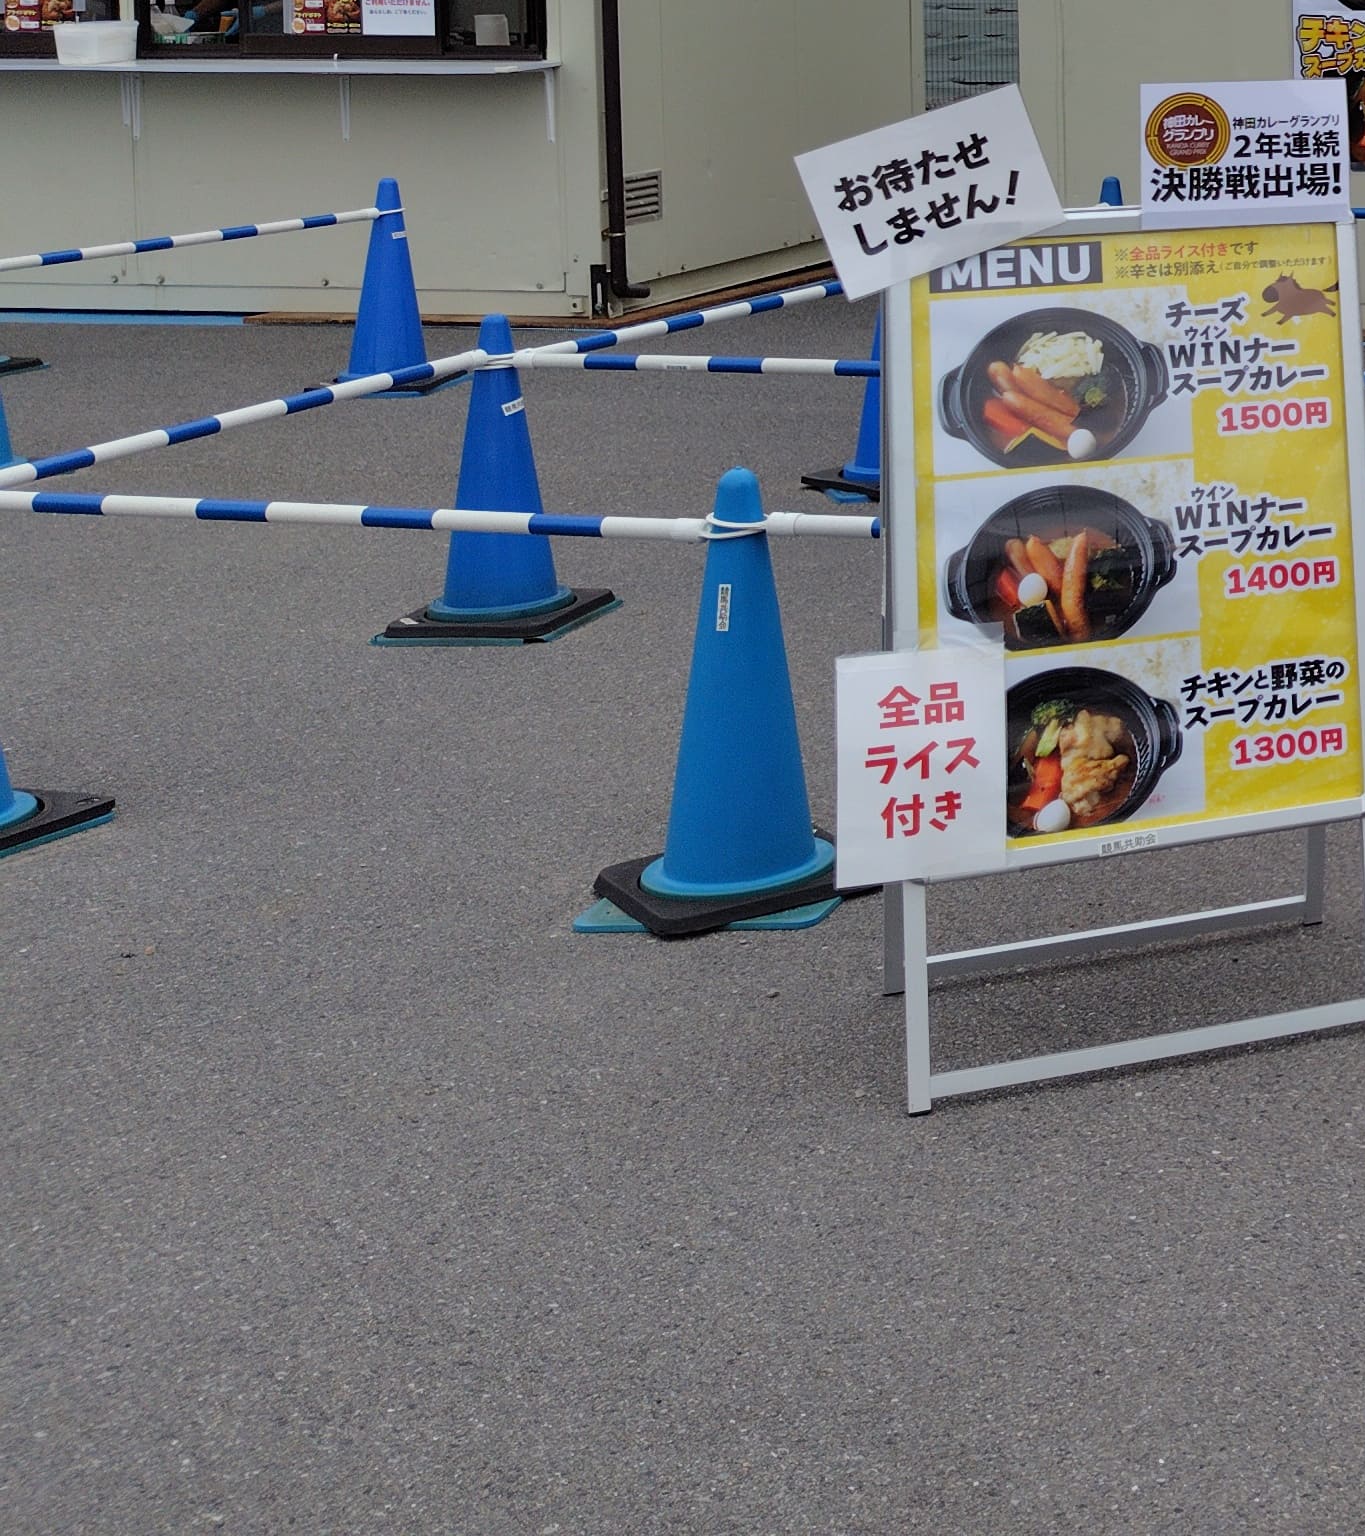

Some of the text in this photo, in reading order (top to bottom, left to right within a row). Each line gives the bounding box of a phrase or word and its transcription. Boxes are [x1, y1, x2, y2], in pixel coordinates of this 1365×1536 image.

[1162, 128, 1215, 143] グランプリ
[1232, 114, 1340, 131] 神田カレーグランプリ
[1233, 130, 1340, 160] 2年連続
[834, 132, 991, 214] お待たせ
[941, 244, 1091, 289] MENU
[1164, 297, 1246, 327] チーズ
[1184, 325, 1228, 342] ウイン
[1168, 340, 1296, 367] WINナー
[1170, 364, 1327, 398] スープカレー
[1220, 401, 1329, 435] 1500円
[1190, 485, 1233, 502] ウイン
[1174, 499, 1305, 532] WINナー
[1179, 526, 1334, 559] スープカレー
[1227, 559, 1337, 595] 1400円
[1180, 661, 1345, 703] チキンと野菜の
[877, 680, 966, 730] 全品
[1185, 691, 1341, 730] スープカレー
[863, 737, 982, 786] ライス
[1233, 728, 1344, 766] 1300円
[881, 791, 964, 840] 付き
